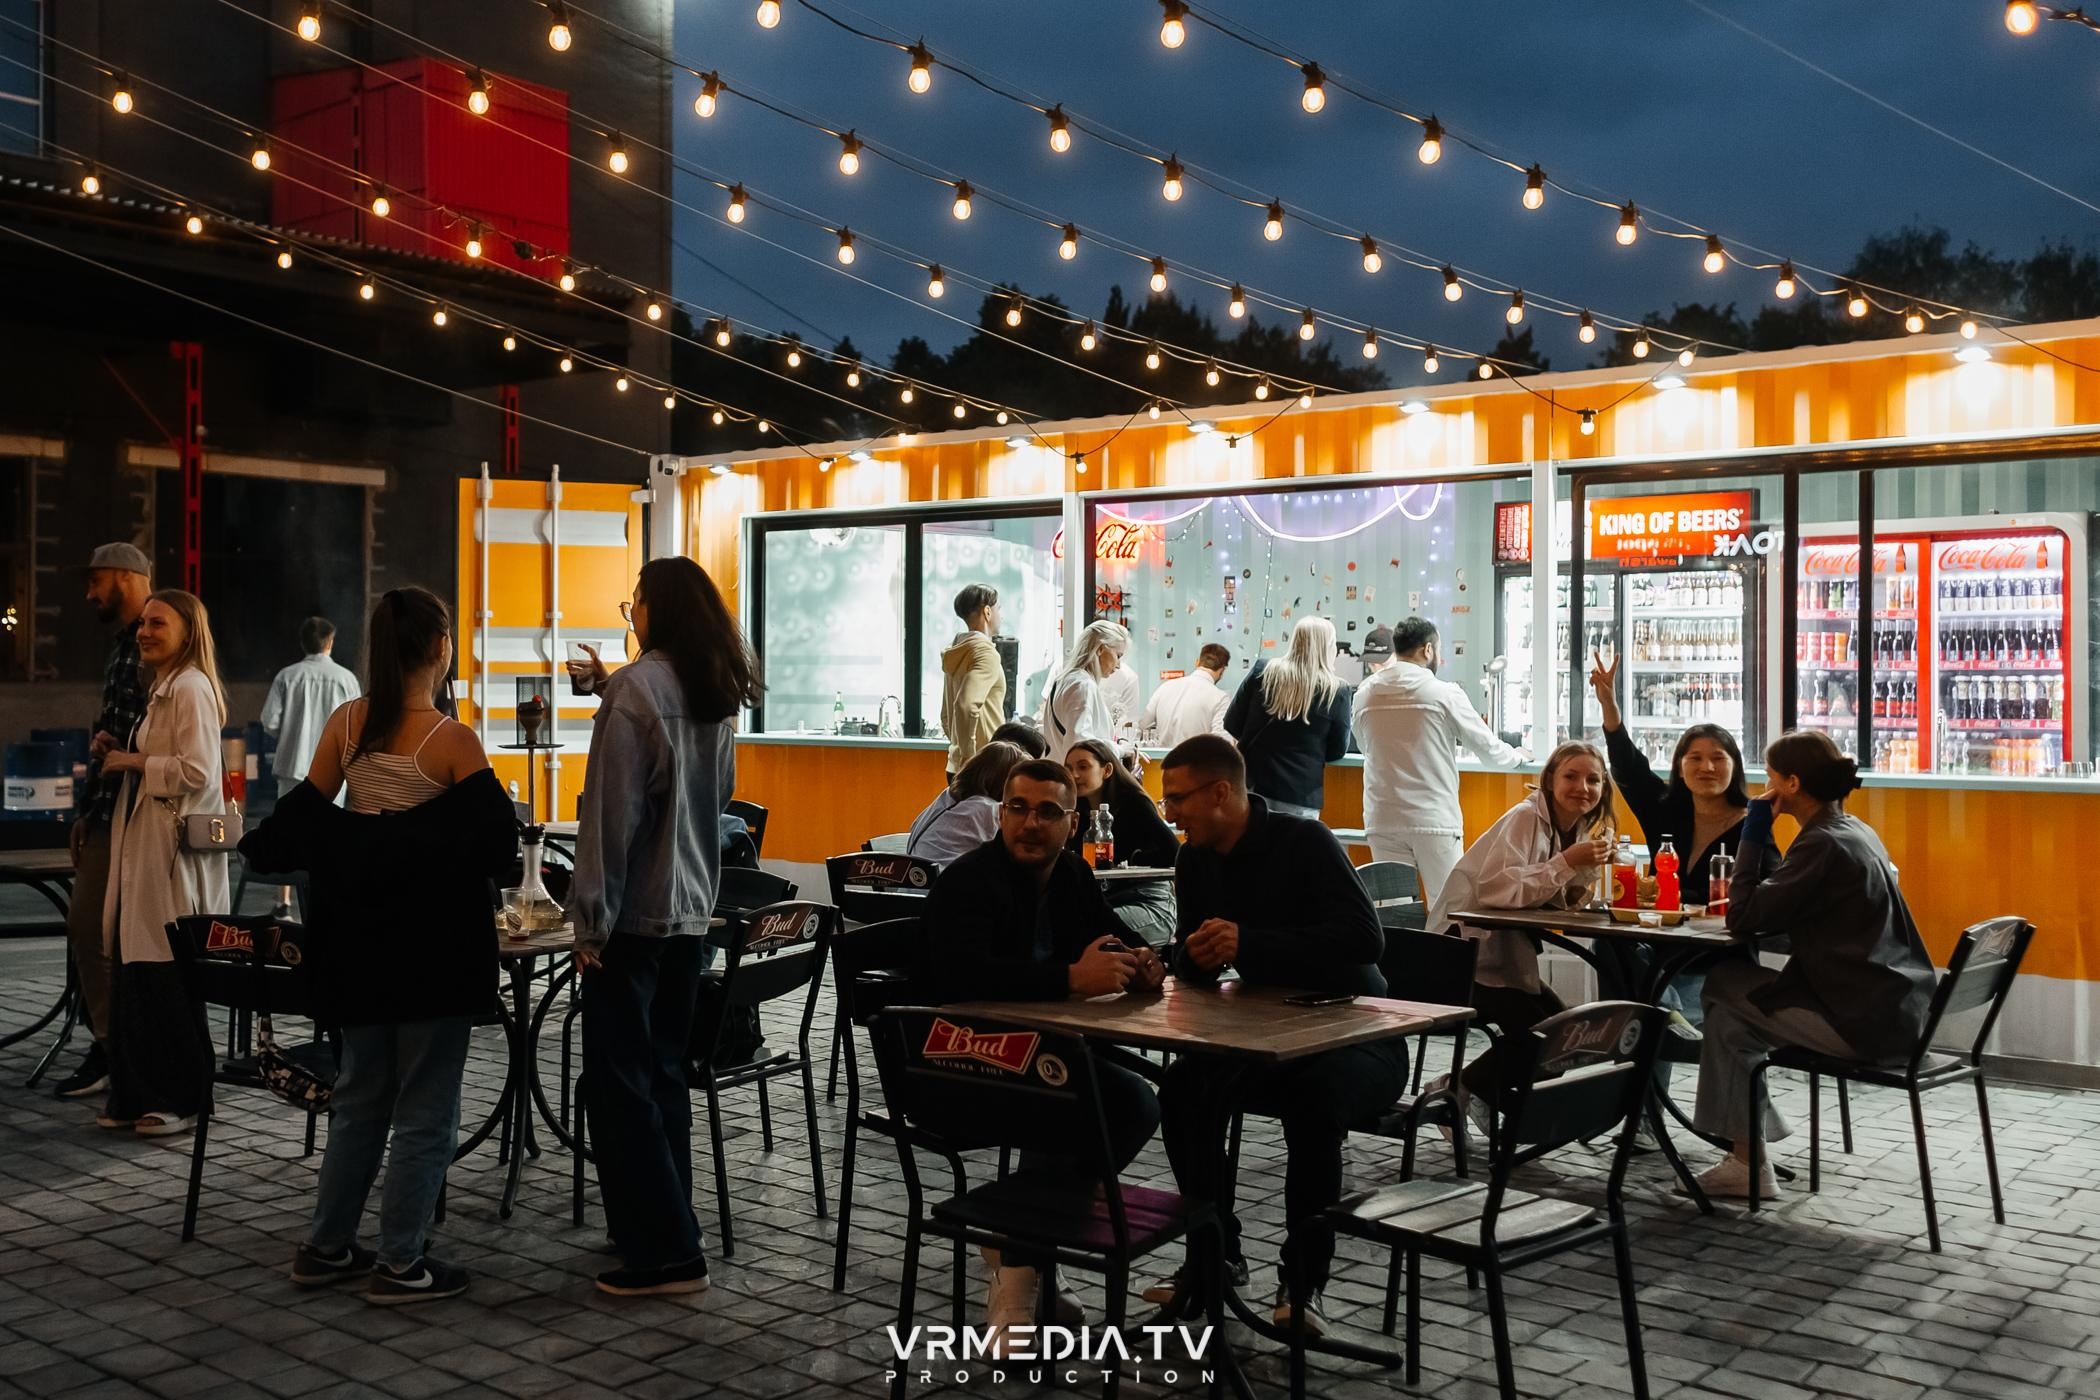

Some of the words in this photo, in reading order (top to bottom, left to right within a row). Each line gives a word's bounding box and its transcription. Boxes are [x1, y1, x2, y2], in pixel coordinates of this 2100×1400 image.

[1599, 513, 1645, 536] KING
[1649, 511, 1674, 534] OF
[1938, 543, 2029, 571] Coca-Cola
[856, 859, 894, 875] Bud
[214, 925, 254, 947] Bu
[761, 912, 797, 936] Bud
[938, 1024, 1009, 1057] Bud
[1563, 1017, 1612, 1052] Bud
